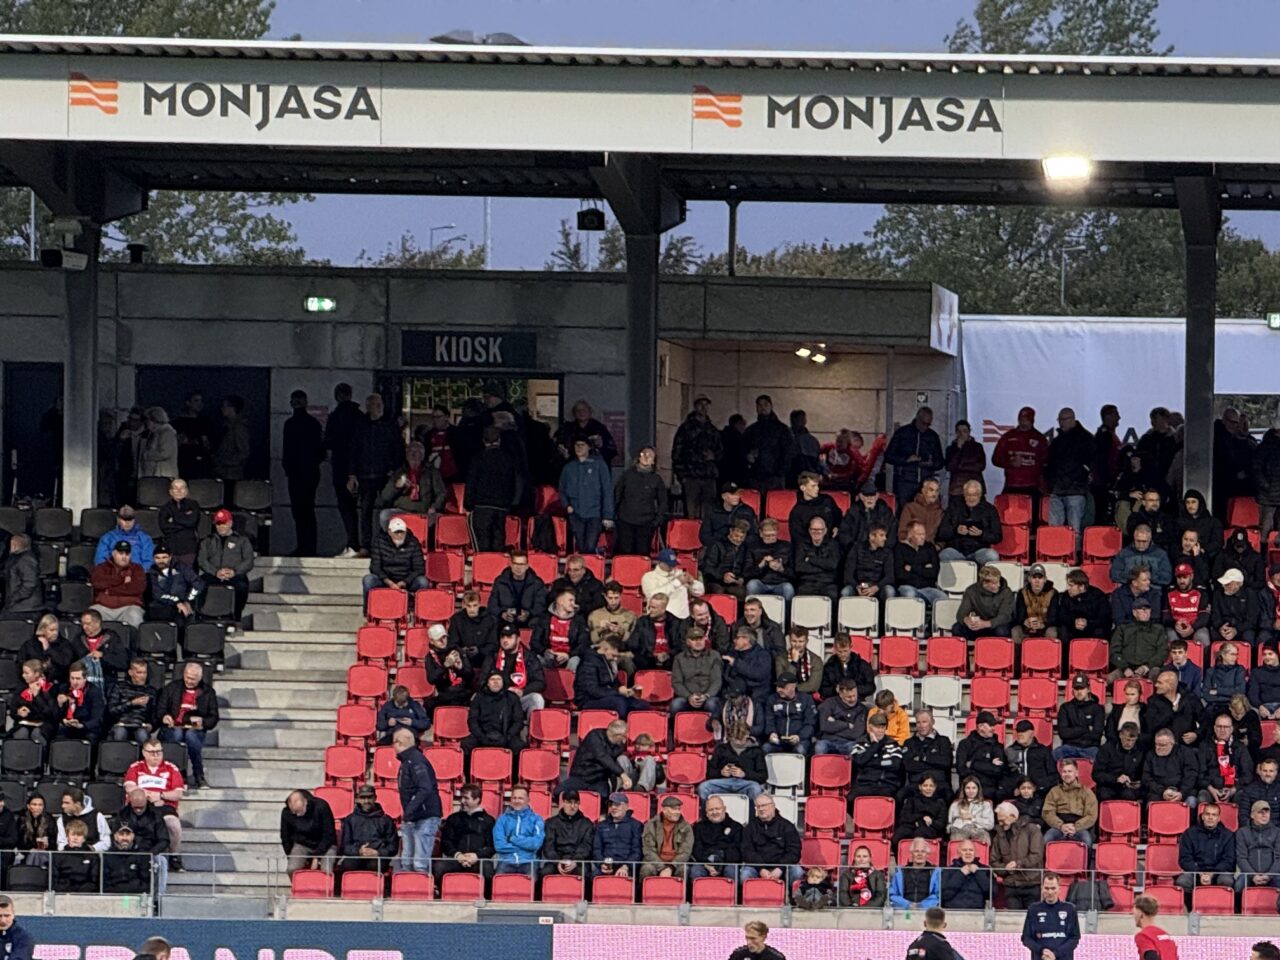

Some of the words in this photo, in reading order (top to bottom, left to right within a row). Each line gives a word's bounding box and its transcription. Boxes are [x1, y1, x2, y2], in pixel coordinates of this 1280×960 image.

[143, 81, 380, 131] MONJASA
[767, 94, 1002, 143] MONJASA
[434, 335, 503, 364] KIOSK
